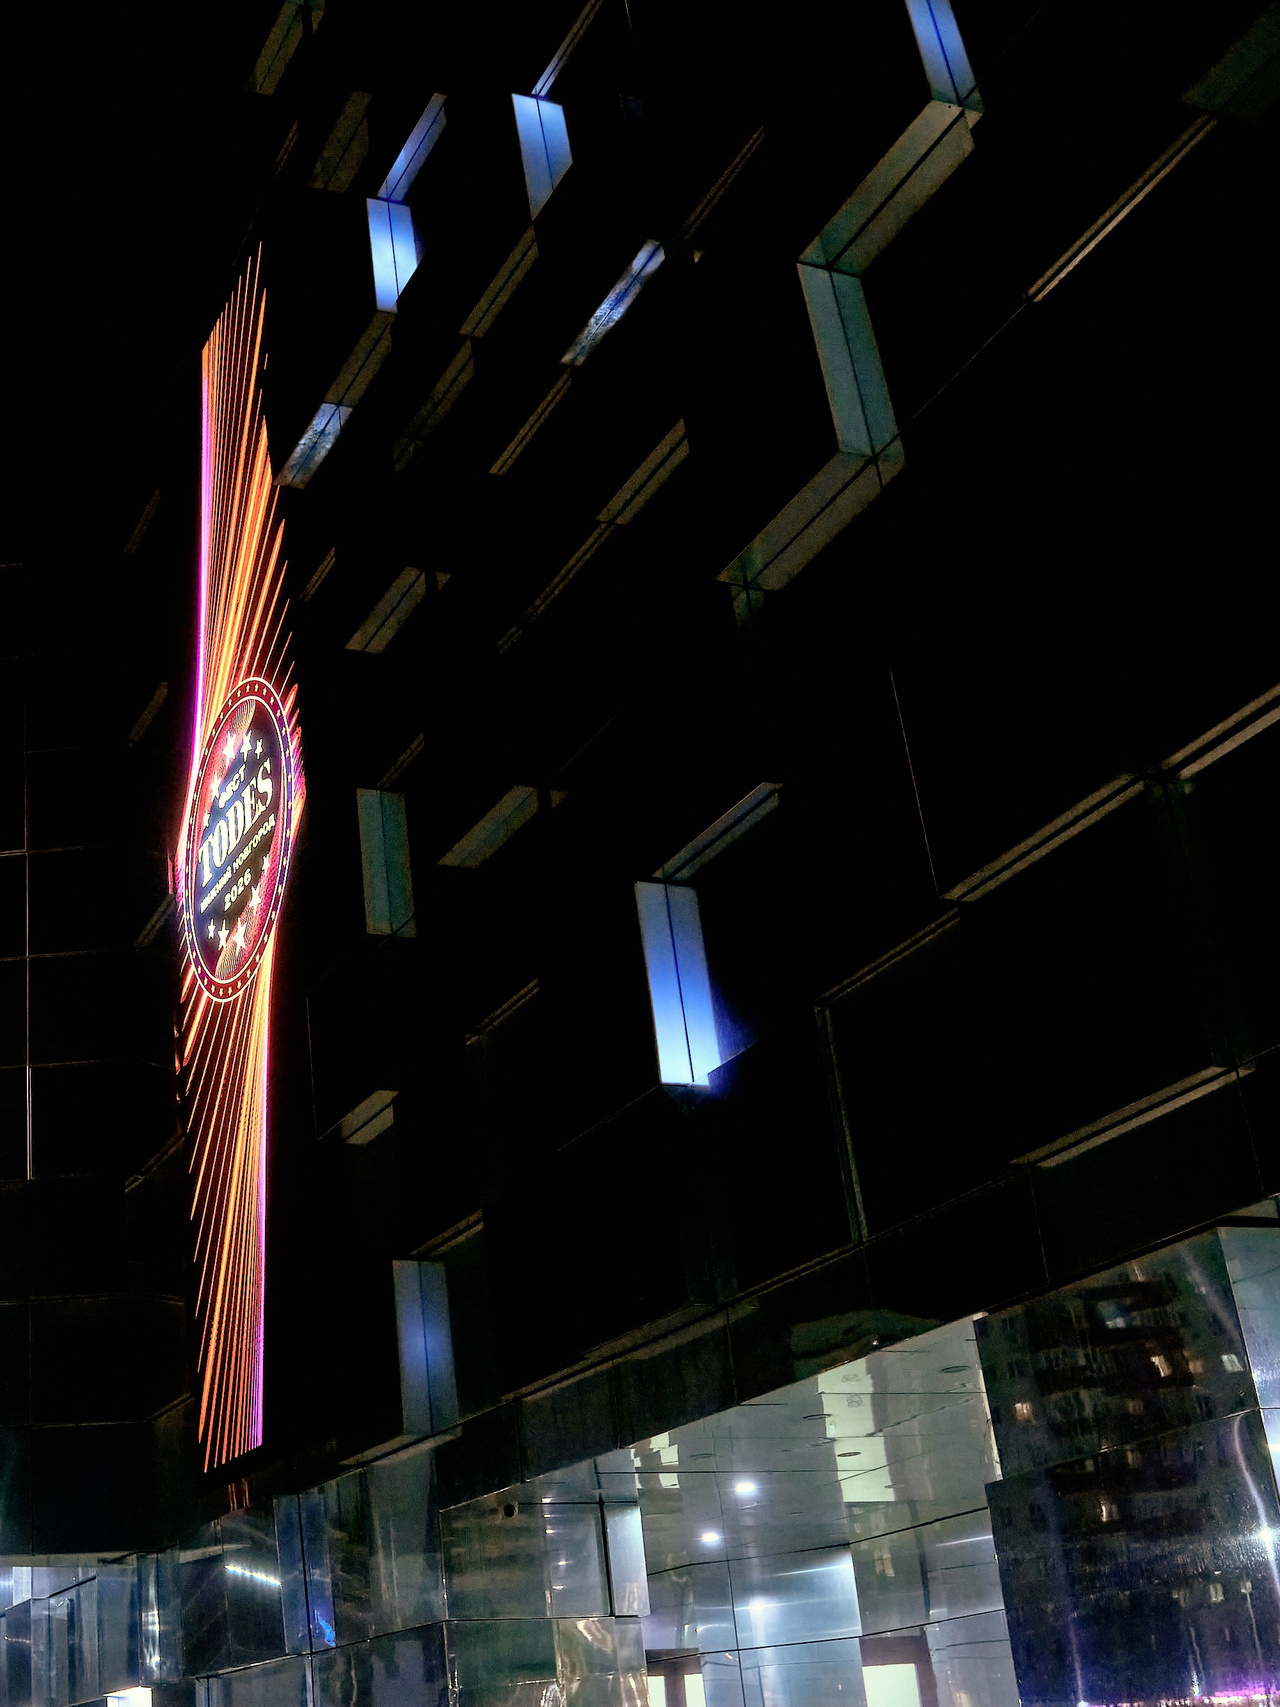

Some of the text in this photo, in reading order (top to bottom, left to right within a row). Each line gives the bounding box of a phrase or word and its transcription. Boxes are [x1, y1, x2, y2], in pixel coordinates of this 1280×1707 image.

[198, 758, 273, 888] TODES
[233, 813, 275, 874] НОВГОРОД
[224, 868, 251, 912] 2026
